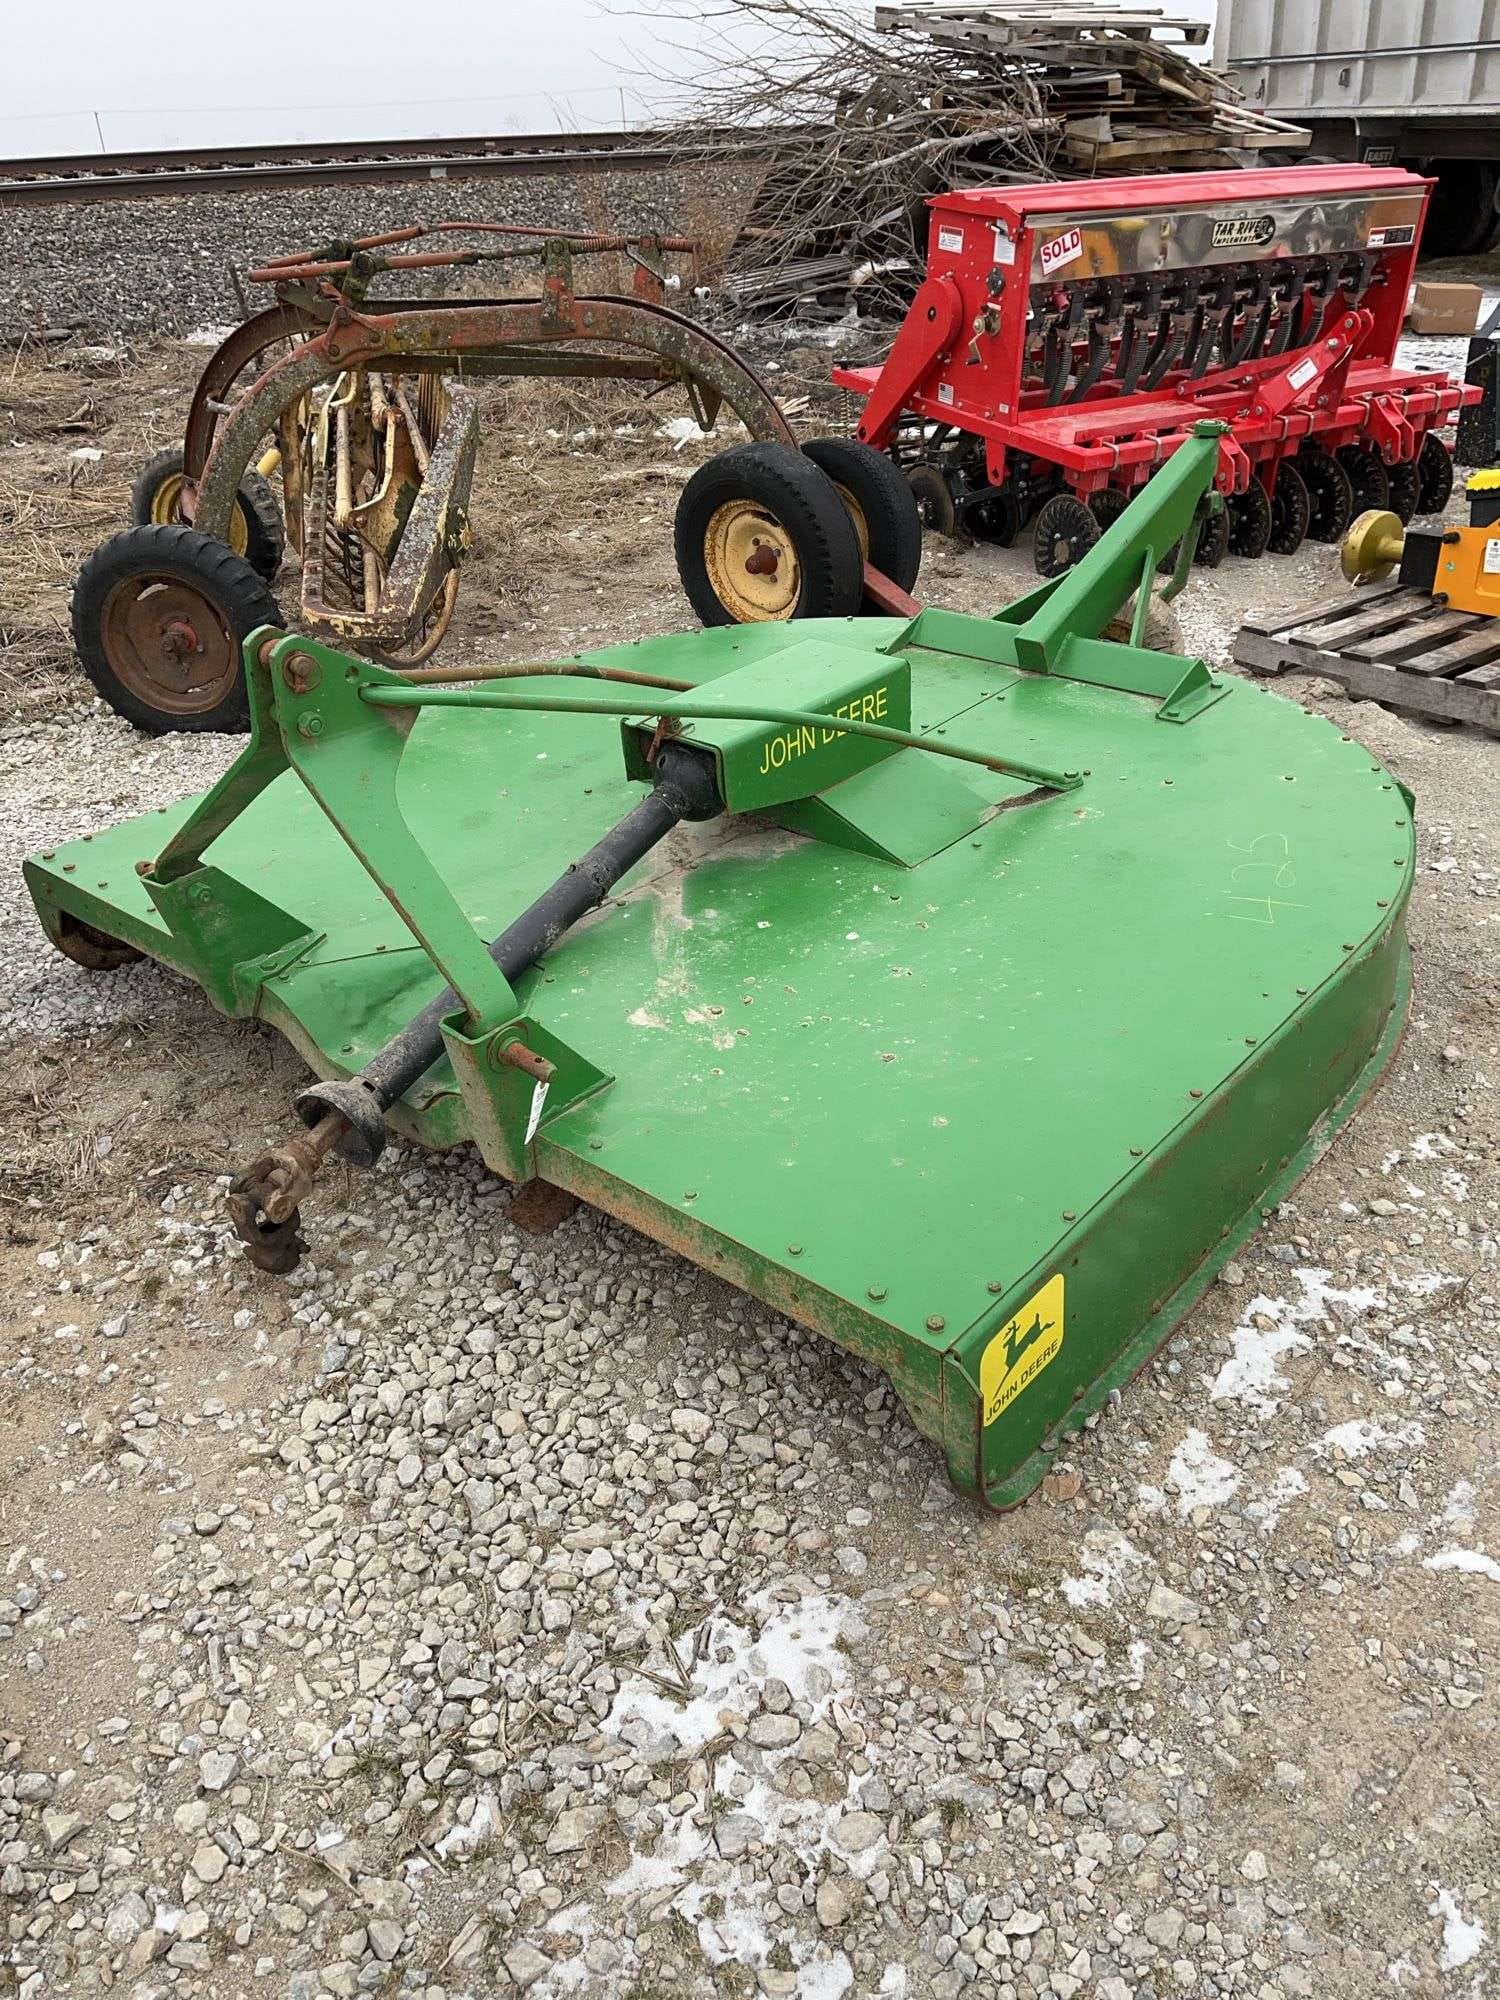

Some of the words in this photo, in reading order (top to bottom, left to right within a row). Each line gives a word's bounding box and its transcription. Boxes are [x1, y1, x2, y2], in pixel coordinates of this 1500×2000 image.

[1043, 231, 1079, 264] SOLD
[1215, 222, 1235, 236] TAR
[760, 725, 815, 774] JOHN
[986, 1381, 1018, 1421] JOHN
[1020, 1338, 1058, 1385] DEERE
